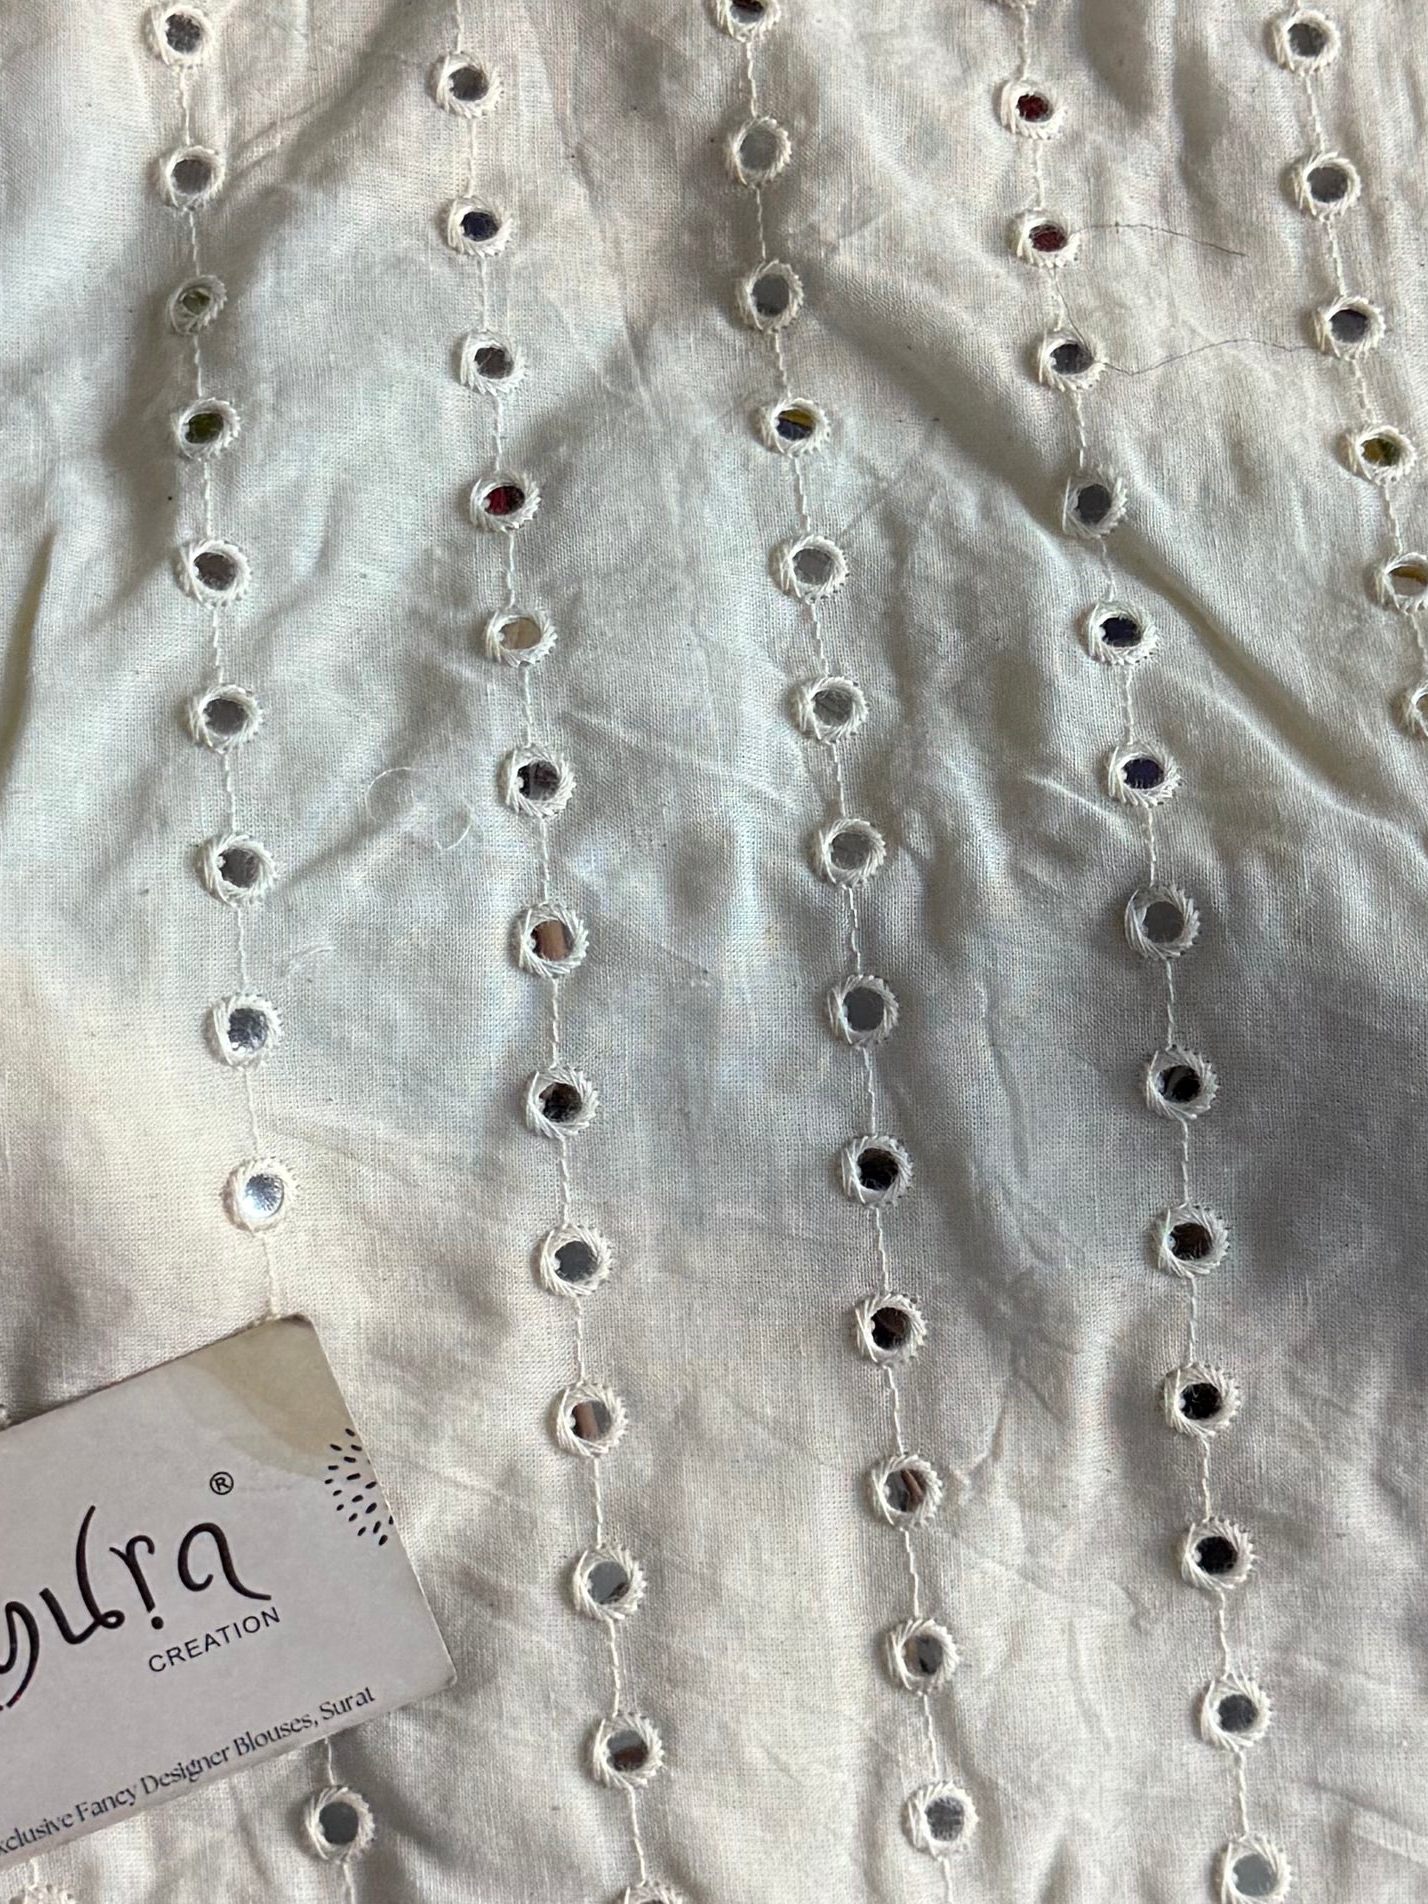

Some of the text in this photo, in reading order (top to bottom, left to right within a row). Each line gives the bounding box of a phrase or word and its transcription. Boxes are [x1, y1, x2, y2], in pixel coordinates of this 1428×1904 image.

[148, 1606, 281, 1673] CREATION
[75, 1785, 137, 1822] Fancy
[141, 1747, 230, 1794] Designer
[233, 1713, 319, 1756] Blouses,
[319, 1687, 376, 1721] Surat
